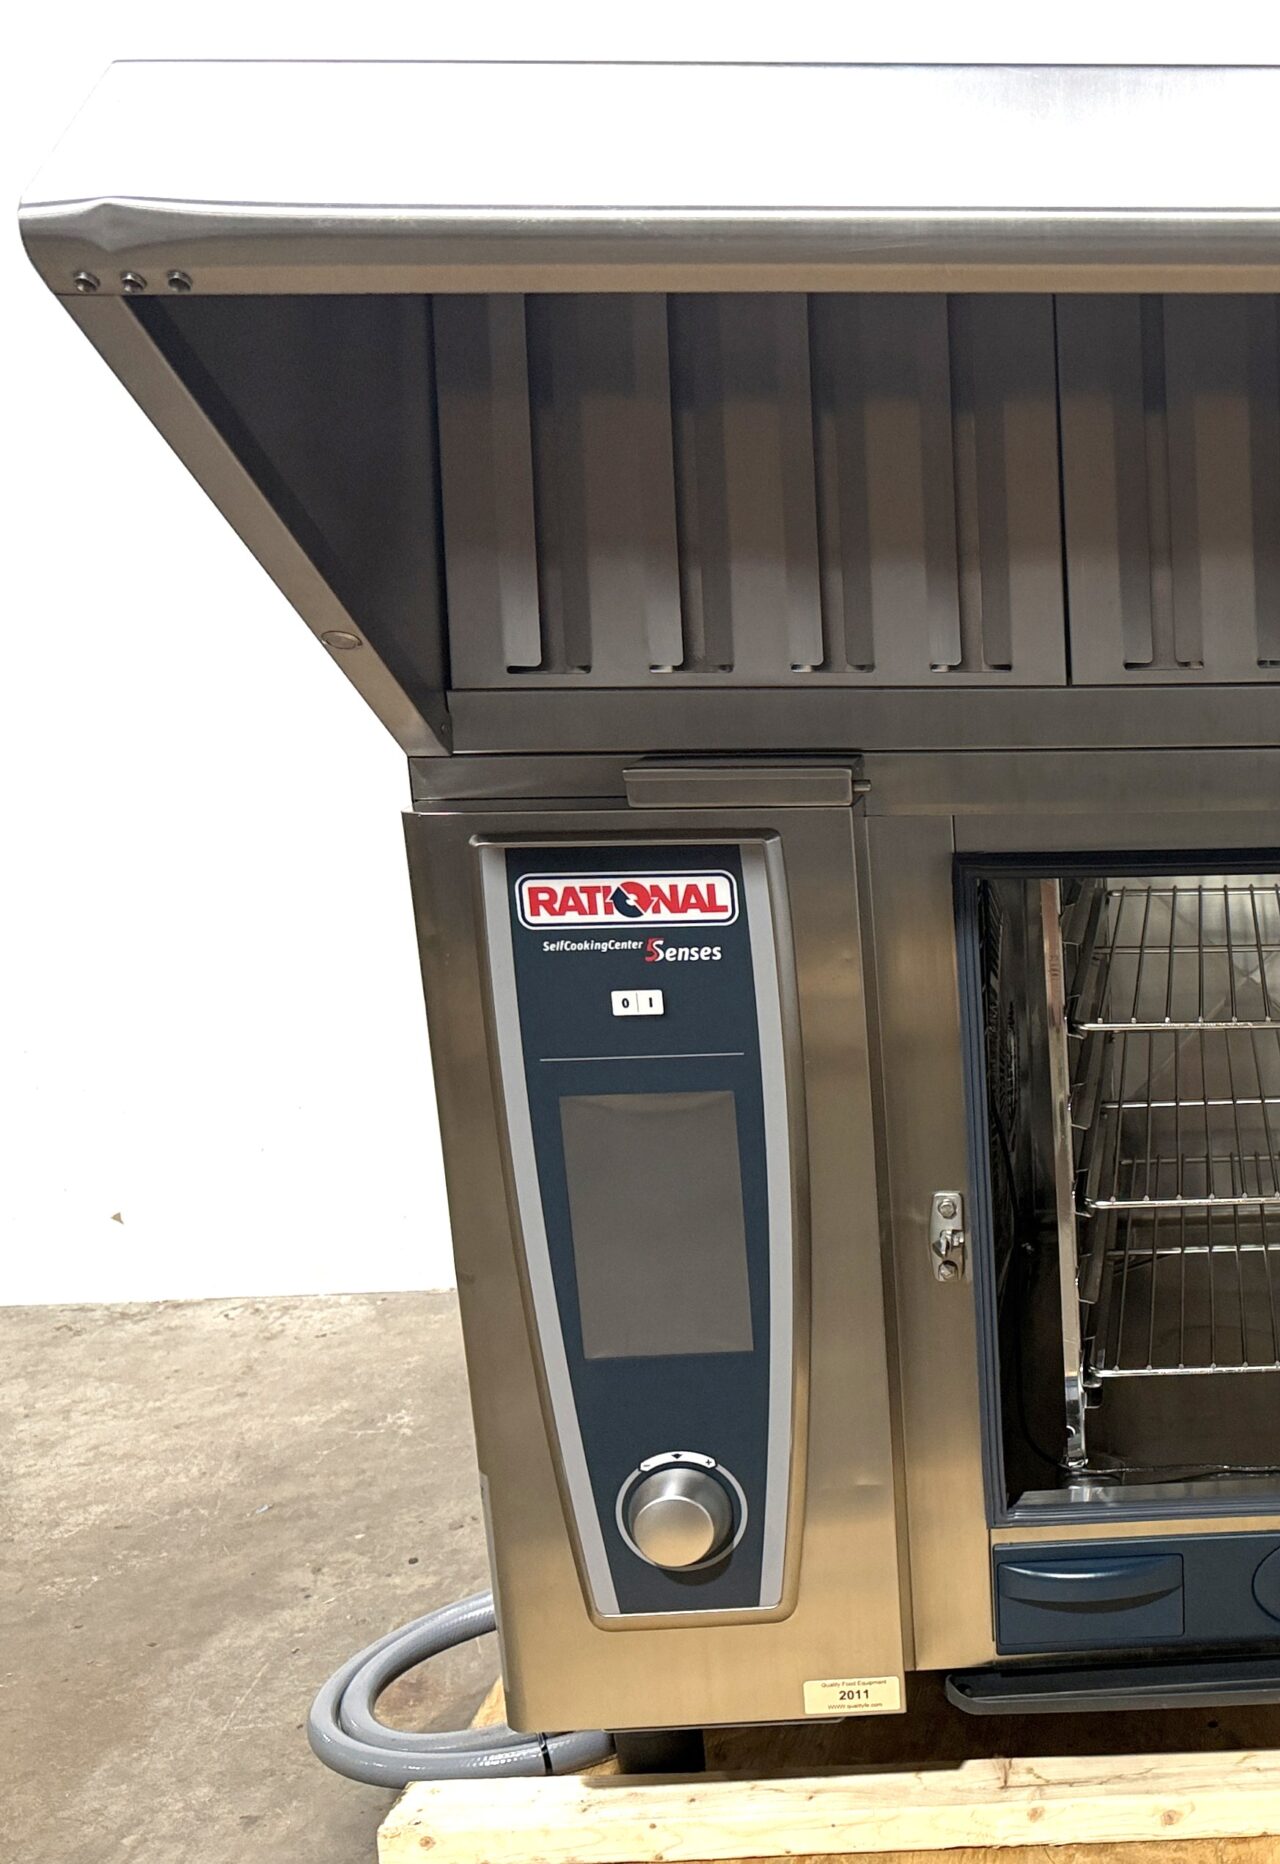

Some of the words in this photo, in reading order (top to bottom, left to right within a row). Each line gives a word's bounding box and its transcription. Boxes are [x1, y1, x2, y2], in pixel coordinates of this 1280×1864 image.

[527, 881, 729, 919] RATIONAL
[543, 939, 643, 953] SelfCookingCenter
[839, 1689, 869, 1701] 2011
